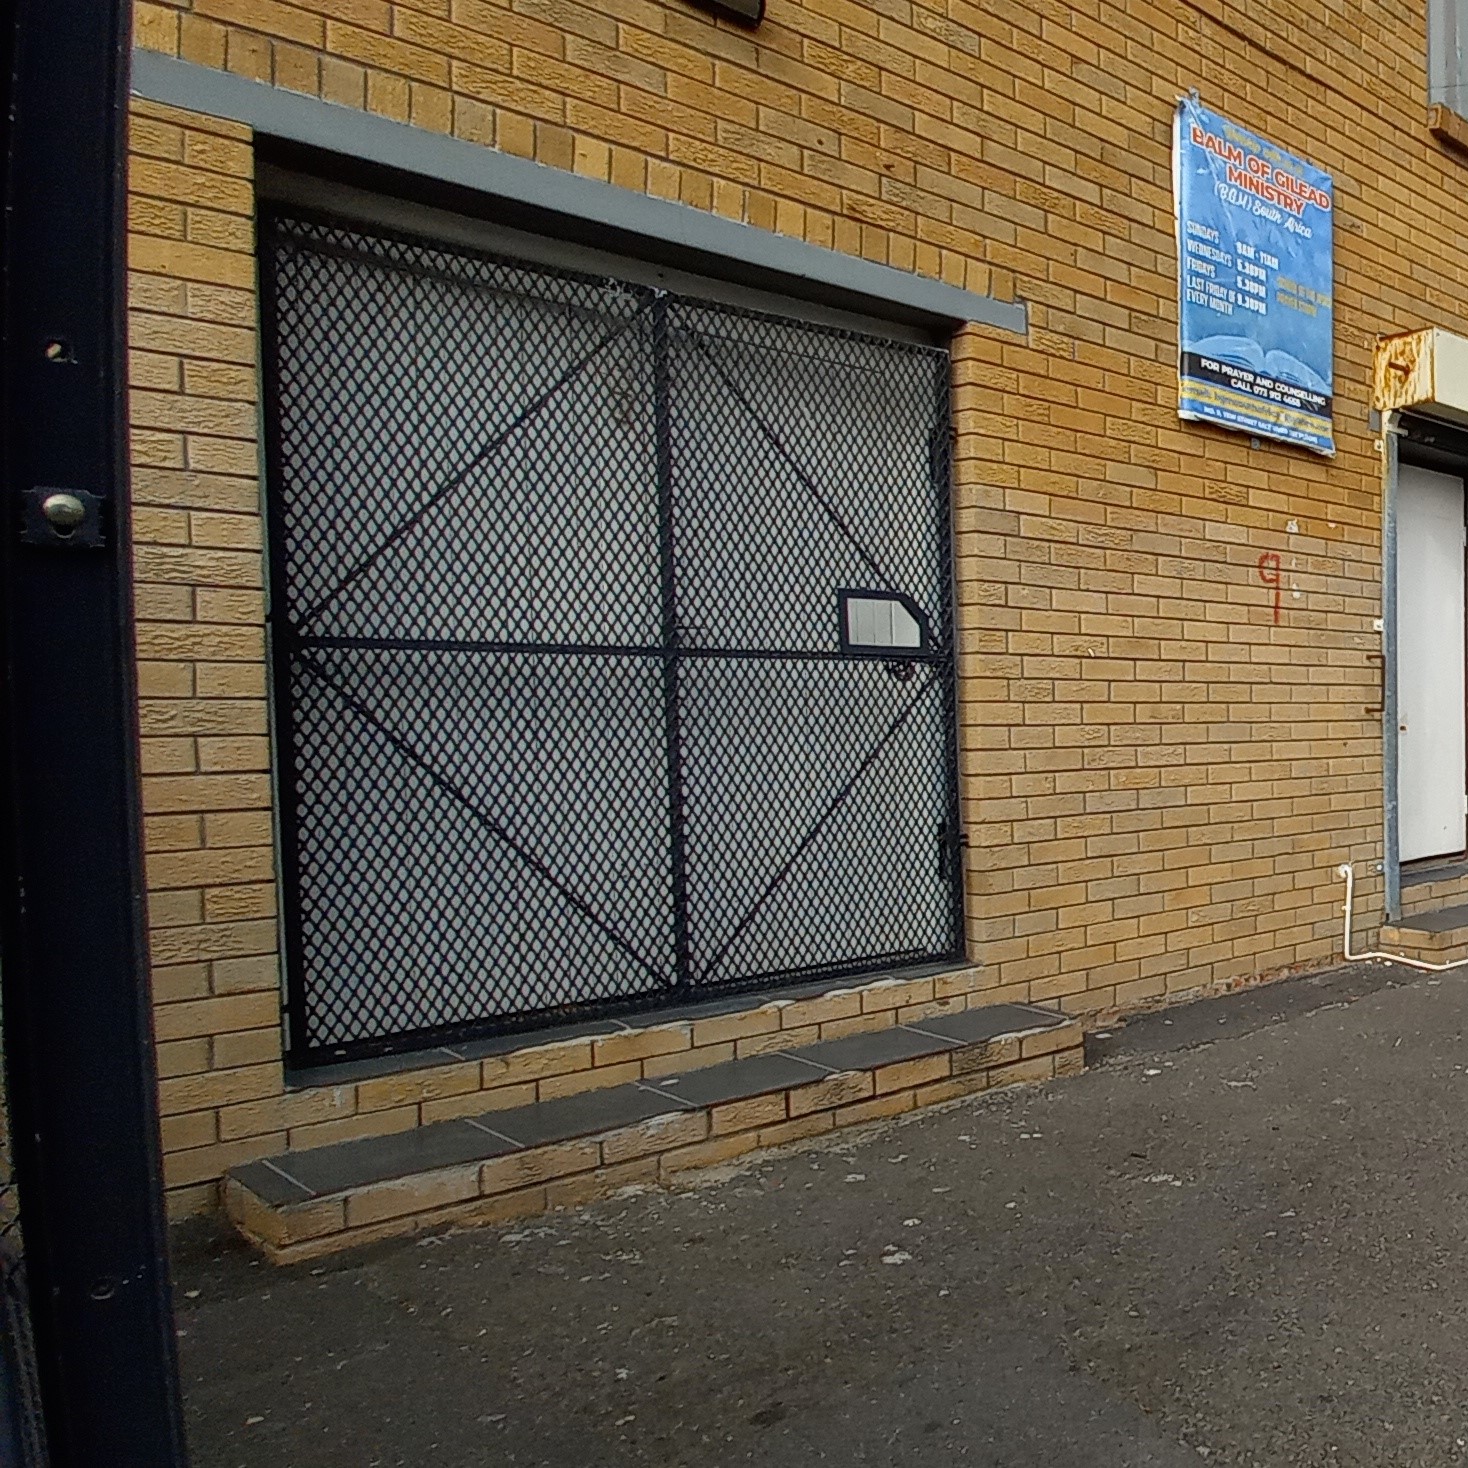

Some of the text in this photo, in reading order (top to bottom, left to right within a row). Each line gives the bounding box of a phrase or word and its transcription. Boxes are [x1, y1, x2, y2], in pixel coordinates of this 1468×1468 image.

[1191, 125, 1243, 167] BALM
[1247, 155, 1271, 180] OF
[1273, 170, 1331, 211] GILEAD
[1227, 165, 1305, 217] MINISTRY
[1252, 200, 1282, 224] South
[1186, 274, 1205, 292] LAST
[1201, 358, 1326, 406] FOR PRAYER AND COUNSELLING
[1230, 378, 1253, 392] CALL
